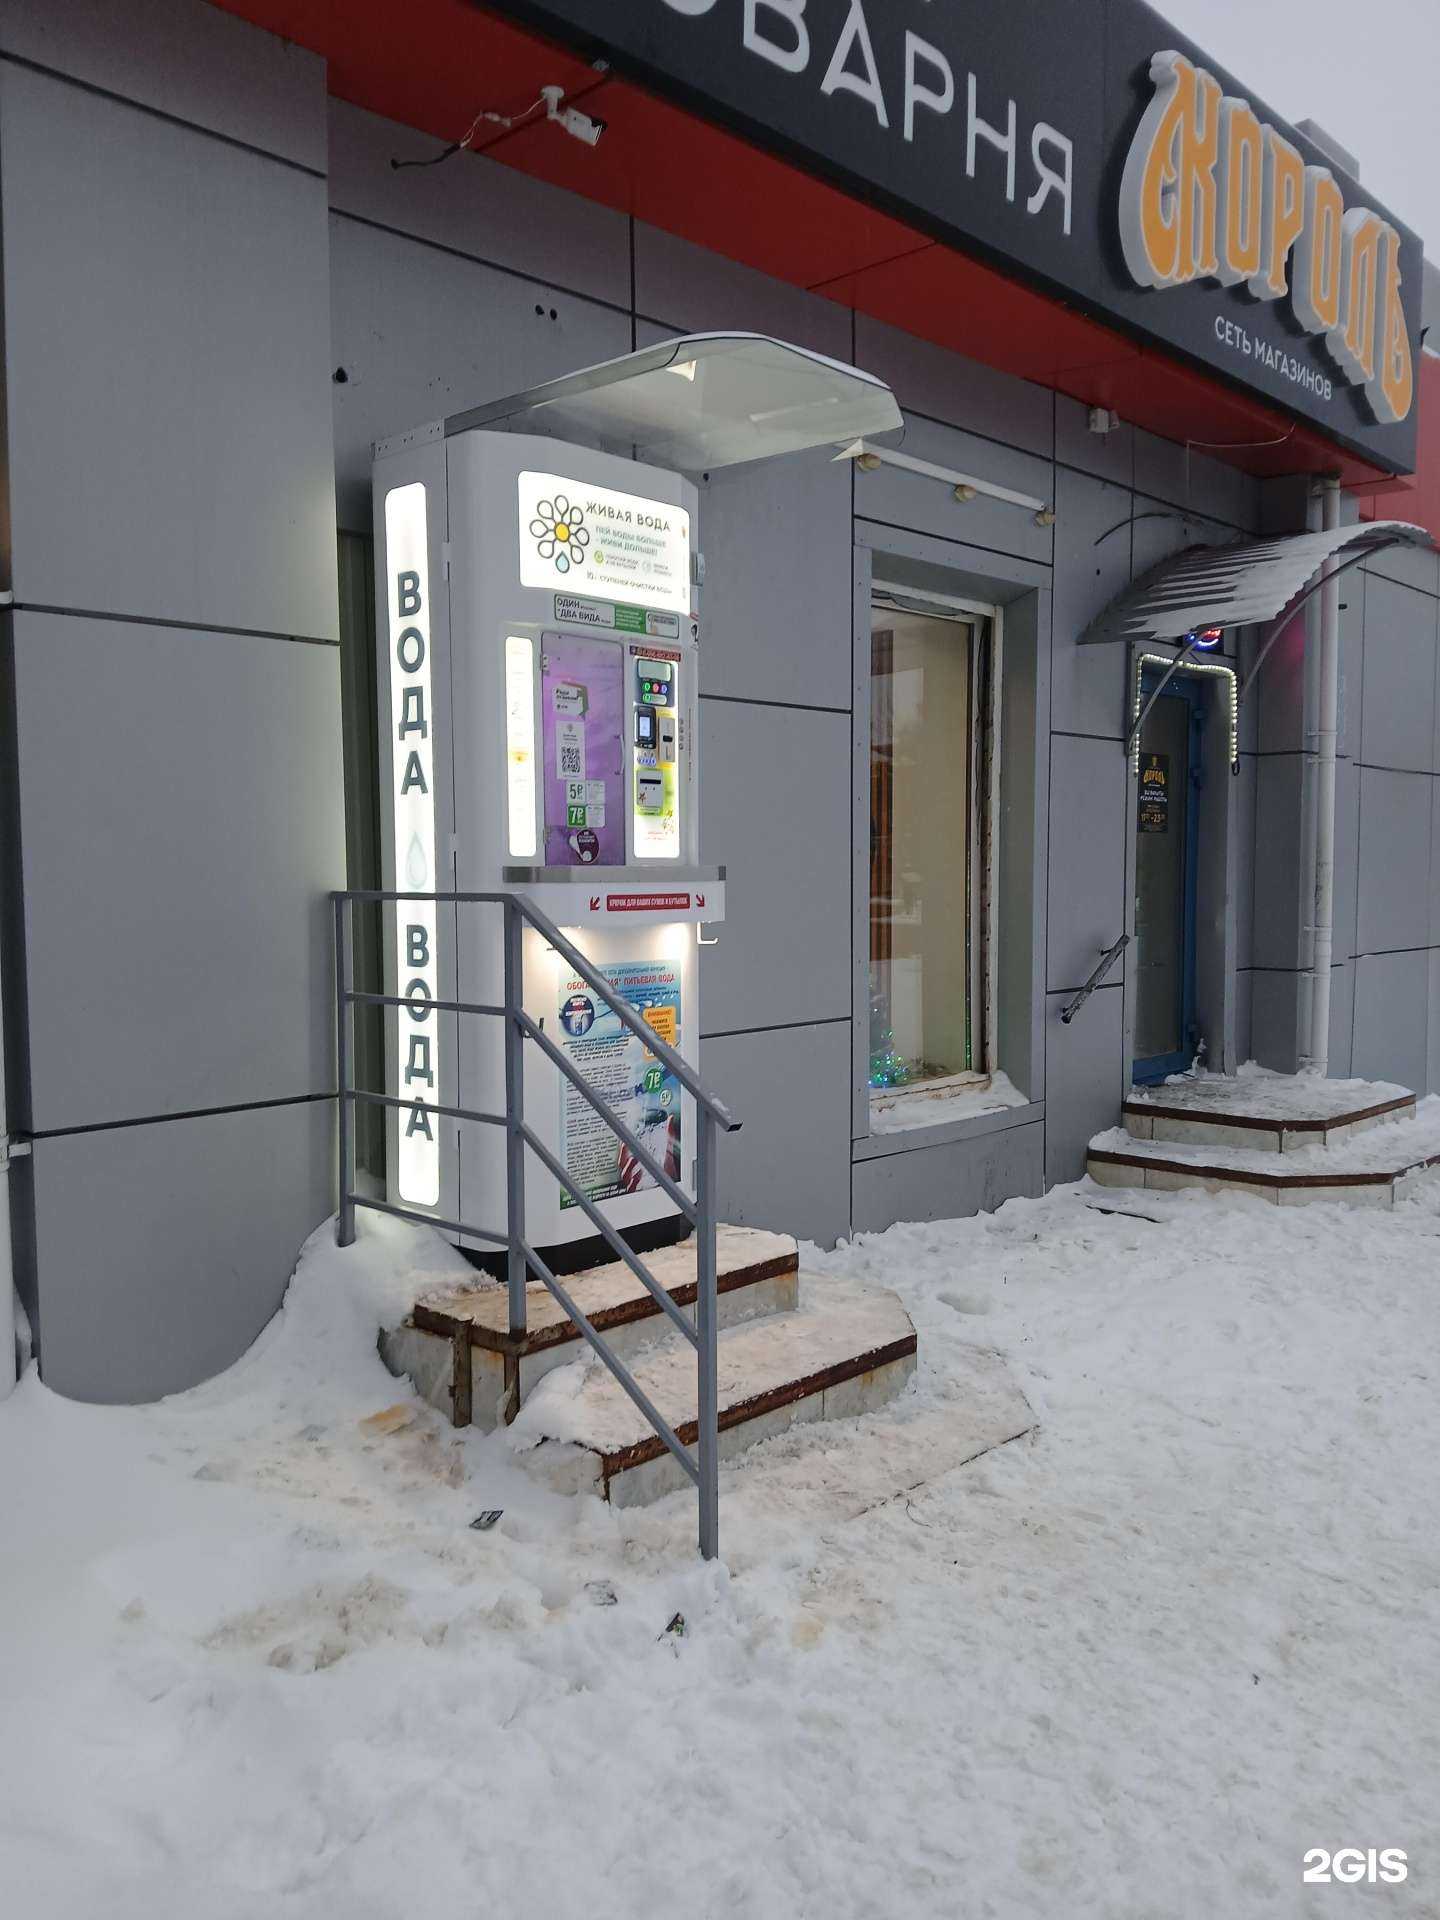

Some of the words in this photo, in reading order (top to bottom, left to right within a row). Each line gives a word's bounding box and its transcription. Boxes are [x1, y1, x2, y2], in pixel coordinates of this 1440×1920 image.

[661, 0, 1073, 236] ВАРНЯ
[1120, 51, 1414, 424] КОРОЛЬ
[1214, 315, 1251, 354] СЕТЬ
[1255, 337, 1332, 400] МАГАЗИНОВ
[557, 597, 580, 609] ОДИН
[585, 501, 632, 523] ЖИВАЯ
[637, 513, 671, 532] ВОДА
[397, 570, 429, 796] ВОДА
[404, 924, 435, 1141] ВОДА
